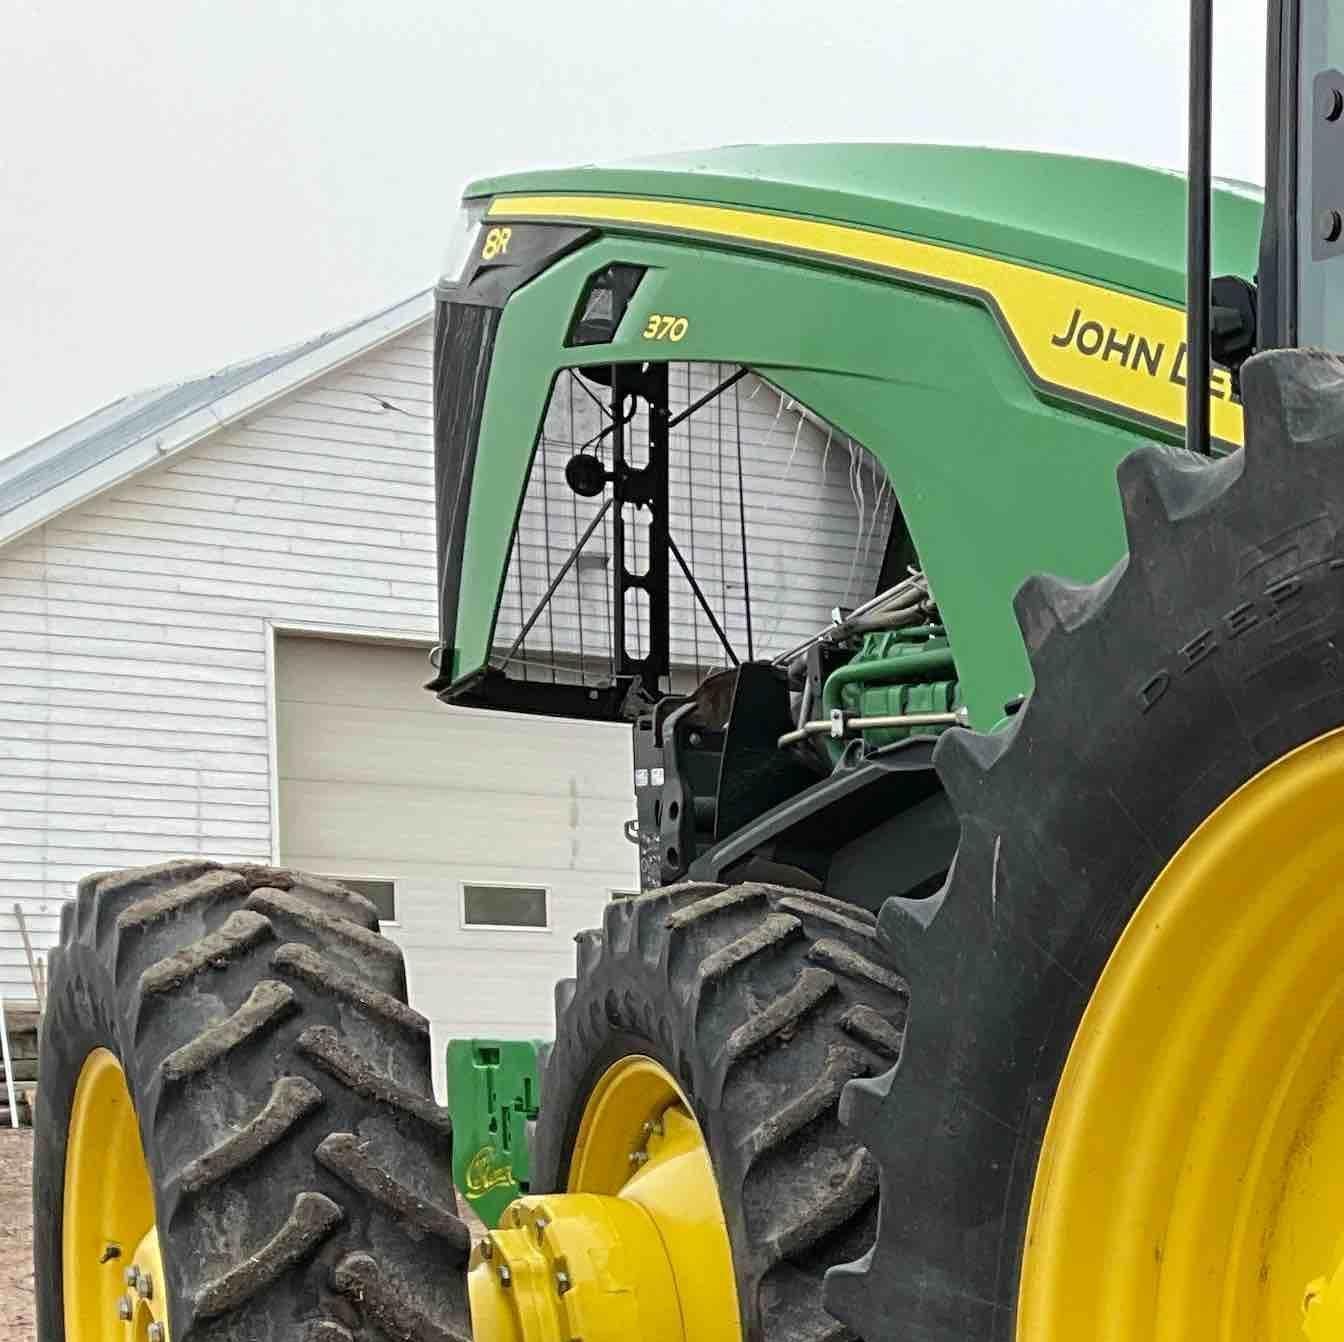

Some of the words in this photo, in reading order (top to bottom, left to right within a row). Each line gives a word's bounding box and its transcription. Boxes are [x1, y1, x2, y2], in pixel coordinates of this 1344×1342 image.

[480, 227, 512, 261] 8R
[643, 314, 690, 343] 370
[1050, 307, 1166, 377] JOHN
